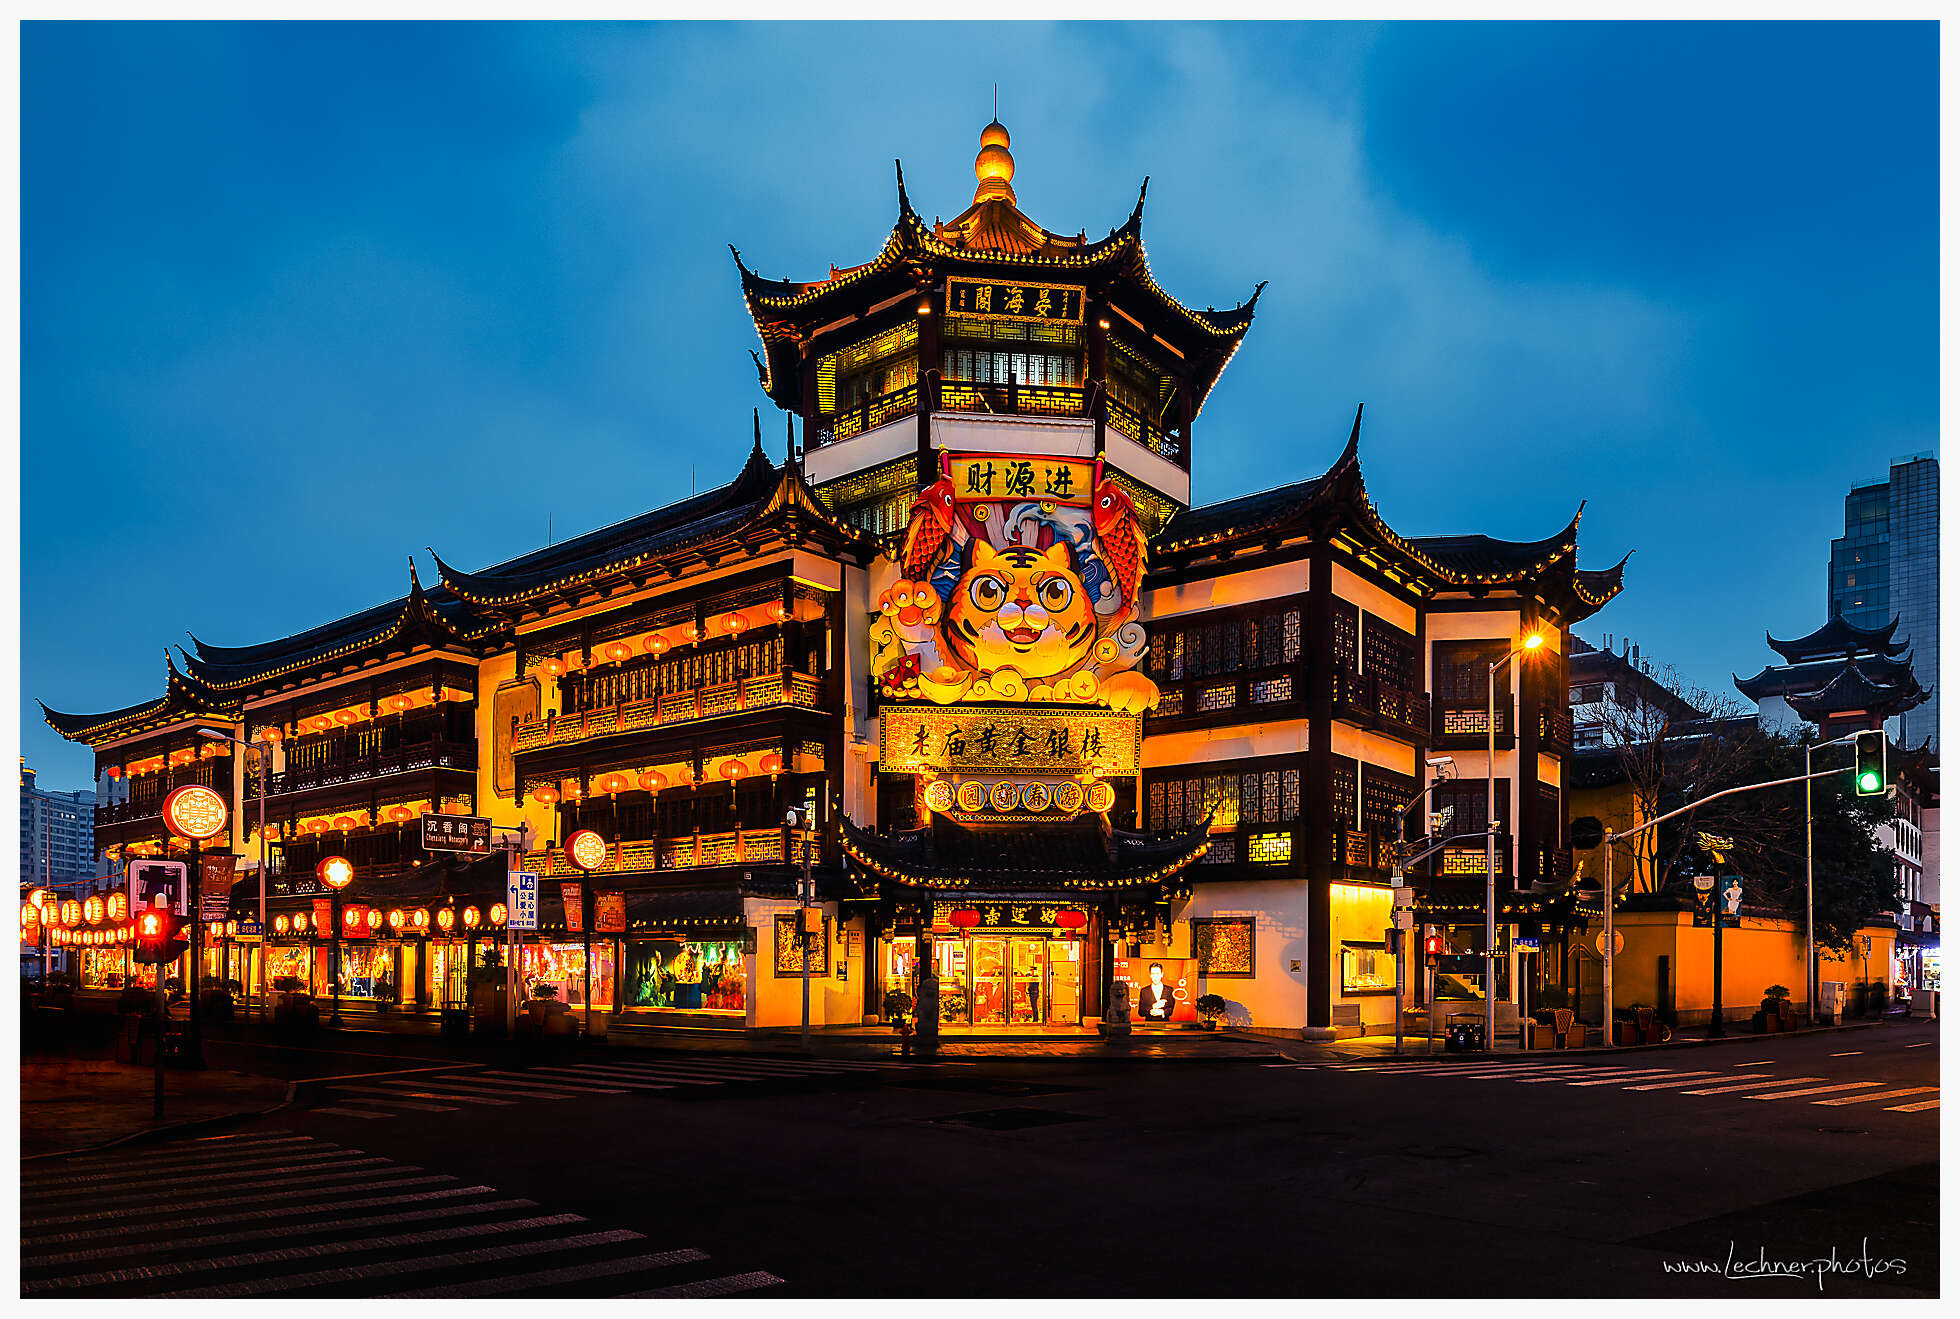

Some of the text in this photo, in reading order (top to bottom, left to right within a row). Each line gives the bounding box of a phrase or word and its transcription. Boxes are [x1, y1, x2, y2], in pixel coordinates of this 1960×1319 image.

[965, 460, 1076, 500] 财源进
[426, 820, 468, 834] 沉香阁
